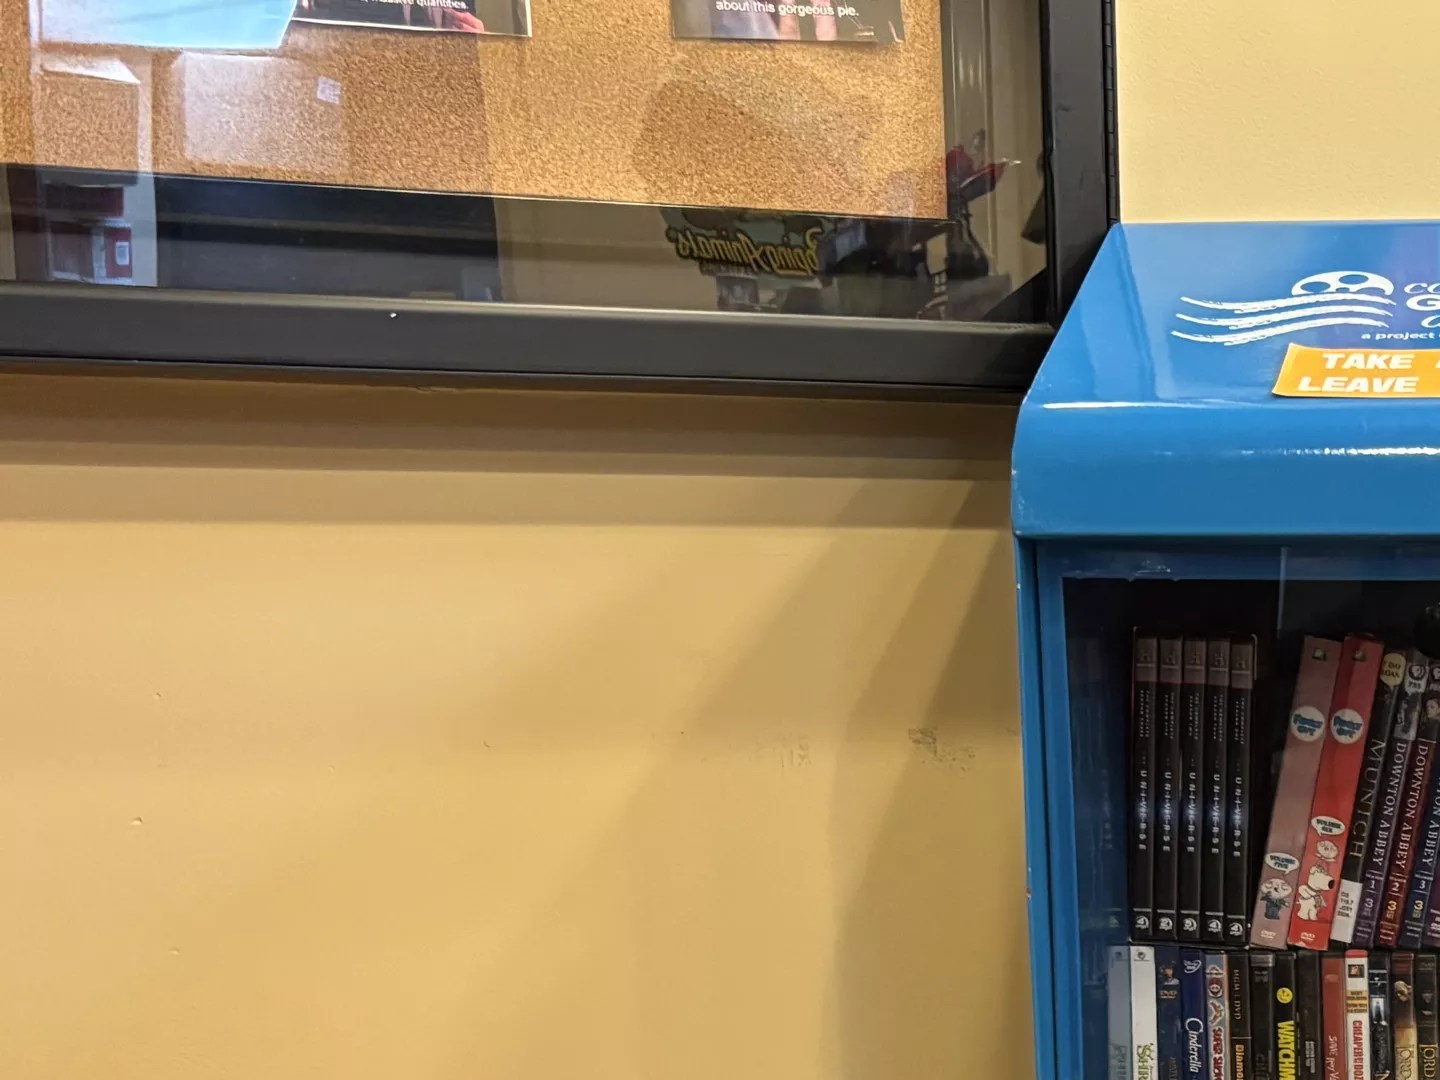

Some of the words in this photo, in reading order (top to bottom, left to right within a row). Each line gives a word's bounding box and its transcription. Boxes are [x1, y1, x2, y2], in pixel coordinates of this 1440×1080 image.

[752, 1, 775, 13] this
[778, 3, 834, 17] gorgeous
[837, 6, 860, 18] pie.
[1375, 331, 1435, 342] project
[1322, 353, 1415, 370] TAKE
[1298, 376, 1419, 393] LEAVE
[1349, 738, 1387, 857] MUNICH
[1382, 742, 1407, 817] DOWNTON
[1405, 744, 1429, 818] DOWNTON
[1372, 819, 1391, 867] ABBEY
[1394, 822, 1412, 868] ABBEY
[1421, 819, 1440, 867] ABBEY
[1233, 1000, 1241, 1020] DVD
[1185, 1018, 1204, 1073] Cinderella
[1212, 1027, 1223, 1056] SUPER
[1353, 1020, 1364, 1057] CHEAPER
[1396, 1044, 1415, 1080] LORD
[1419, 1043, 1439, 1077] LORD
